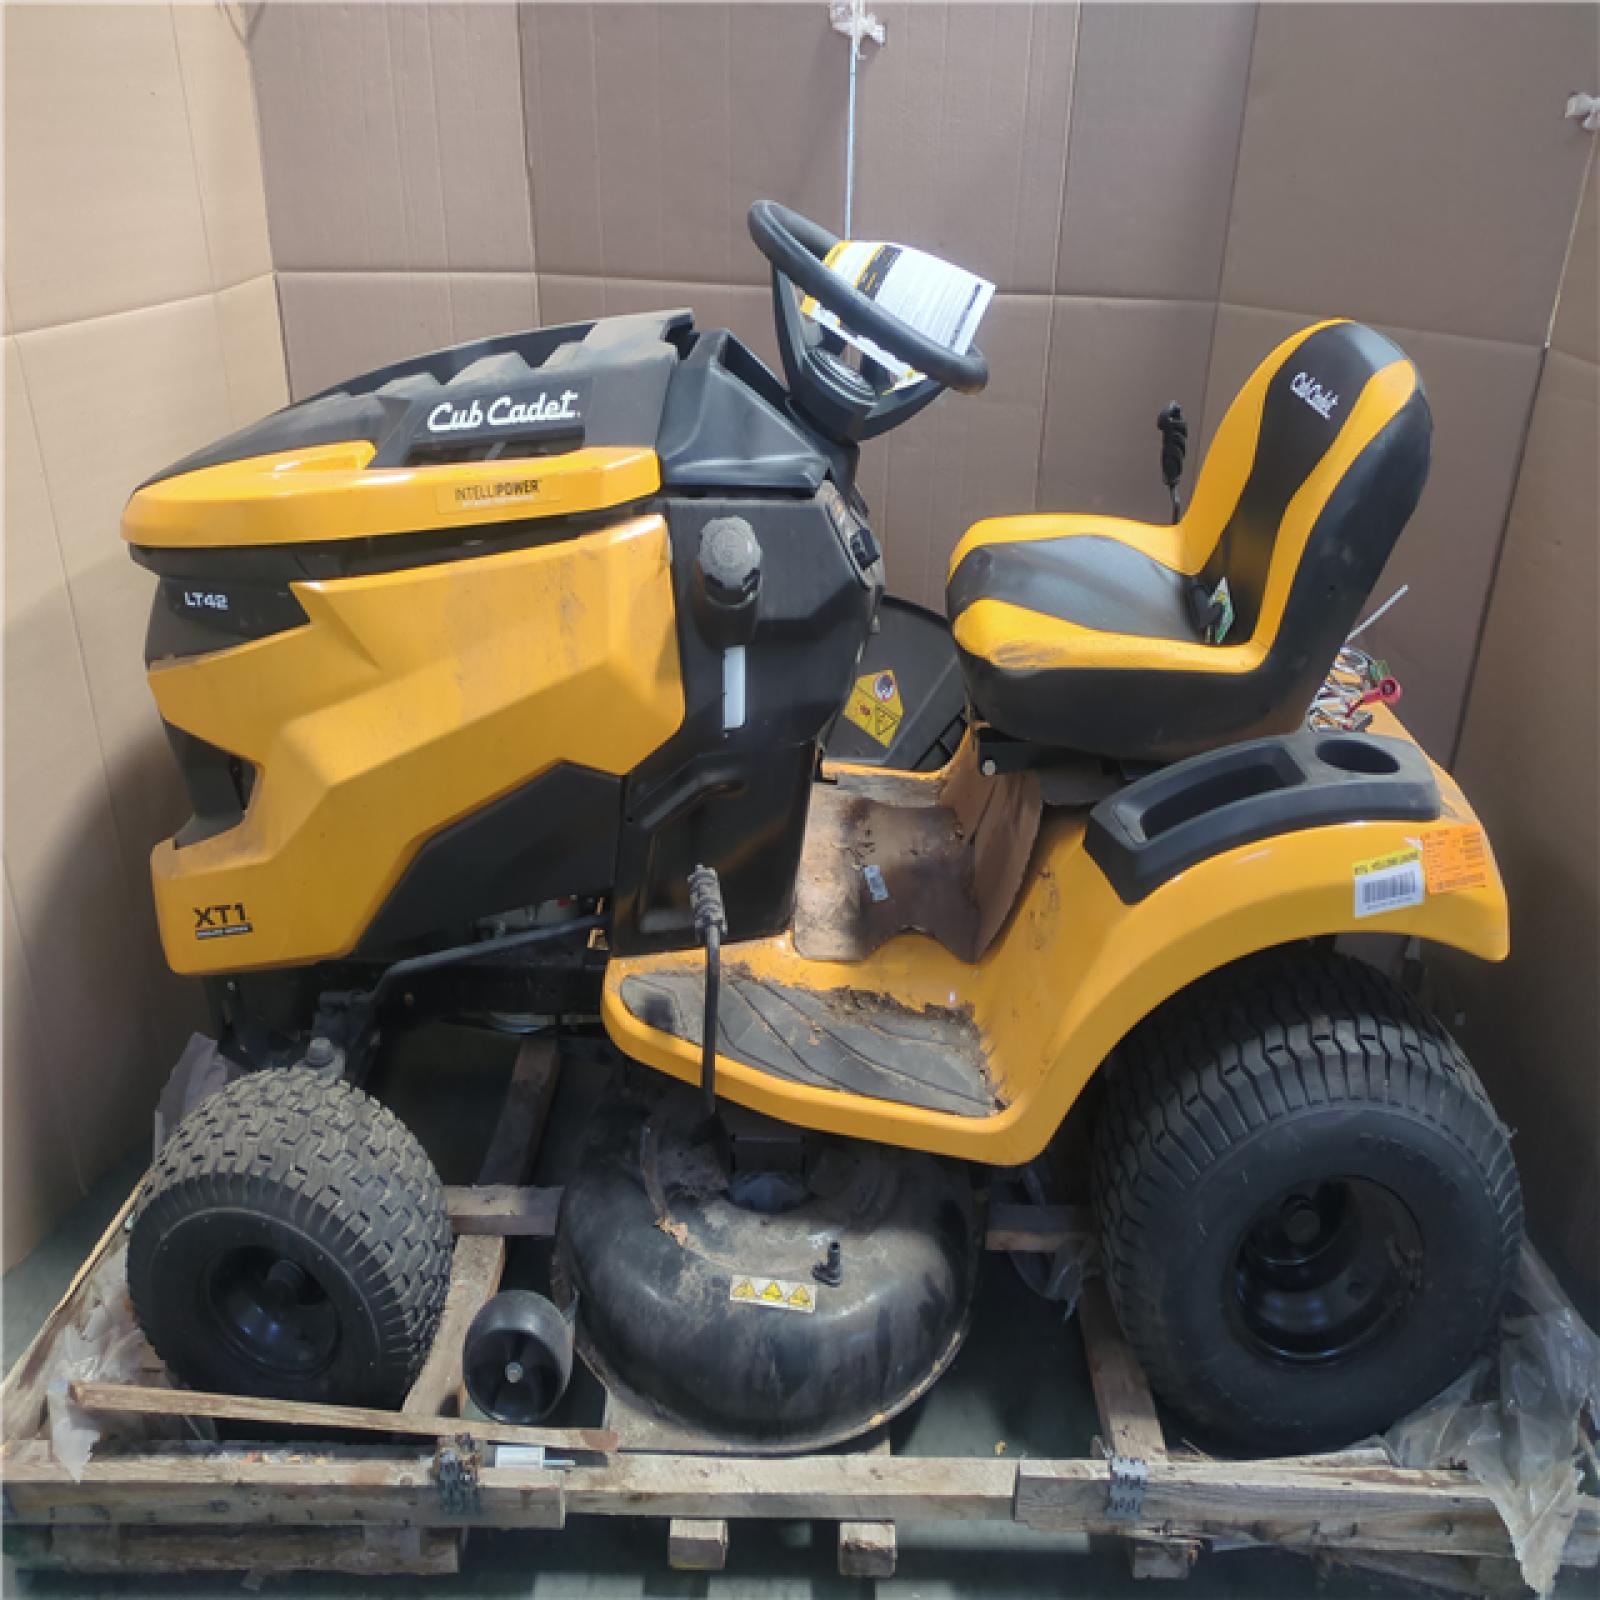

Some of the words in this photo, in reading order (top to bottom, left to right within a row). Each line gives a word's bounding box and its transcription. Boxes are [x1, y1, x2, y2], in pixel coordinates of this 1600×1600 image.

[427, 400, 483, 432] Cub
[487, 389, 579, 426] Cadet
[455, 479, 539, 501] INTELLIPOWER
[184, 591, 229, 610] LT42
[194, 903, 246, 927] XT1
